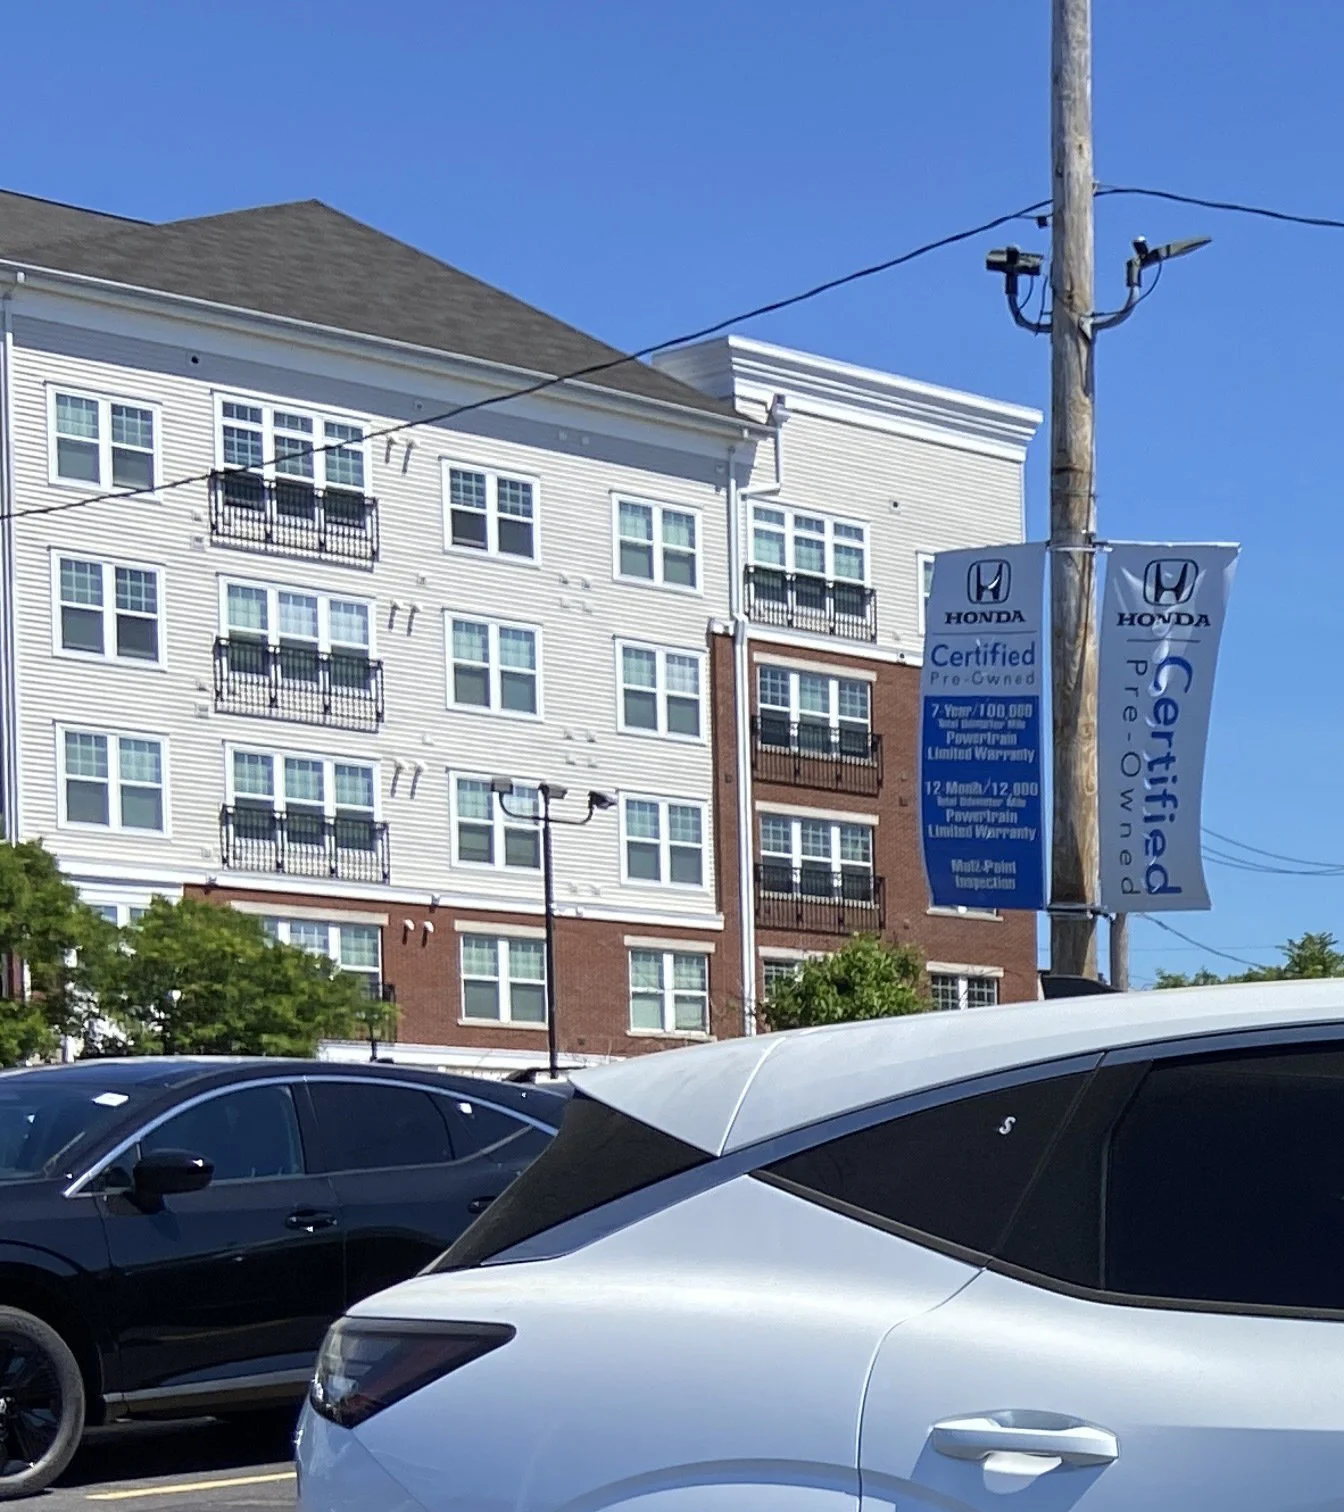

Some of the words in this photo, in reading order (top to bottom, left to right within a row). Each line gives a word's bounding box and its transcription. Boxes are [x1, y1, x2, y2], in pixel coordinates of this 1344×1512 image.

[944, 610, 1026, 624] HONDA
[1116, 612, 1211, 627] HONDA
[931, 640, 1036, 667] Certified
[930, 671, 1036, 686] Pre-Owned
[946, 731, 1018, 746] Powertrain
[927, 747, 972, 761] Limited
[974, 747, 1035, 764] Warranty
[1119, 659, 1147, 895] Pre-Owned
[1142, 656, 1193, 895] Certified
[946, 809, 1018, 825] Powertrain
[927, 825, 972, 839] Limited
[974, 825, 1037, 842] Warranty
[955, 875, 1016, 891] Inspection
